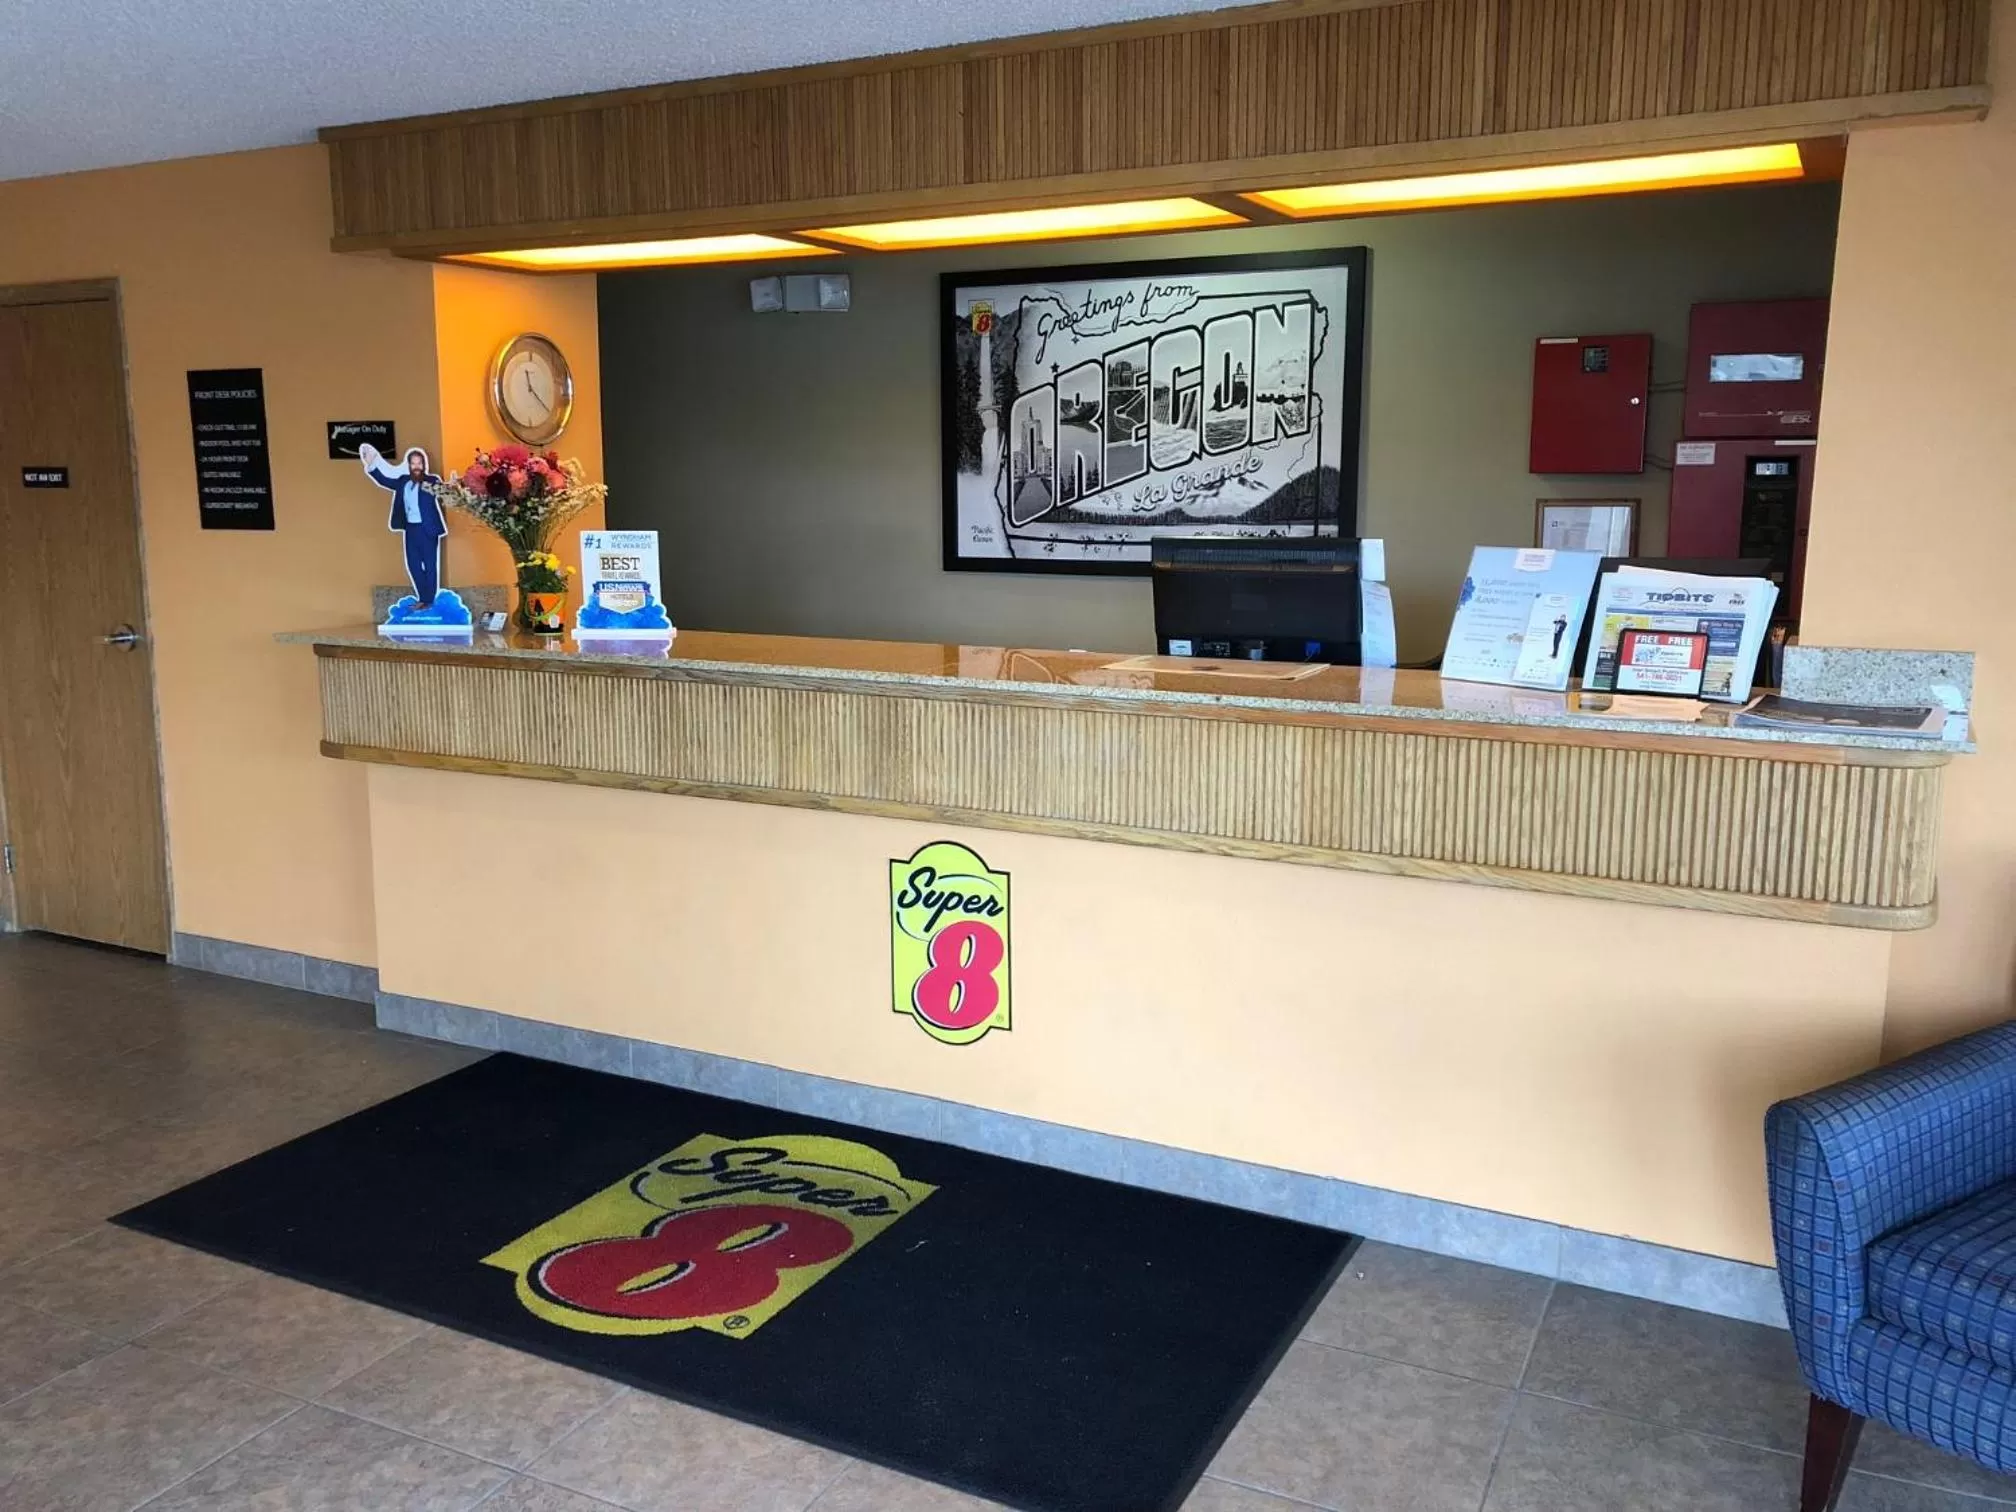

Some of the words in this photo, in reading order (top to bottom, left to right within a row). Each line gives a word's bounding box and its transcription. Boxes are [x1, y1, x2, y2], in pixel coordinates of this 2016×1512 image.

[1035, 288, 1136, 365] Greetings
[1139, 282, 1200, 318] from
[361, 424, 372, 433] On
[372, 424, 387, 434] Duty
[1008, 301, 1313, 529] OREGON
[1131, 483, 1168, 512] La
[1170, 449, 1264, 503] Grande
[584, 533, 602, 549] #1
[600, 556, 641, 571] BEST
[1635, 634, 1659, 645] FREE
[1667, 635, 1694, 646] FREE
[898, 866, 1004, 933] Super
[912, 920, 1005, 1031] 8
[657, 1146, 900, 1217] Super
[526, 1203, 855, 1321] 8
